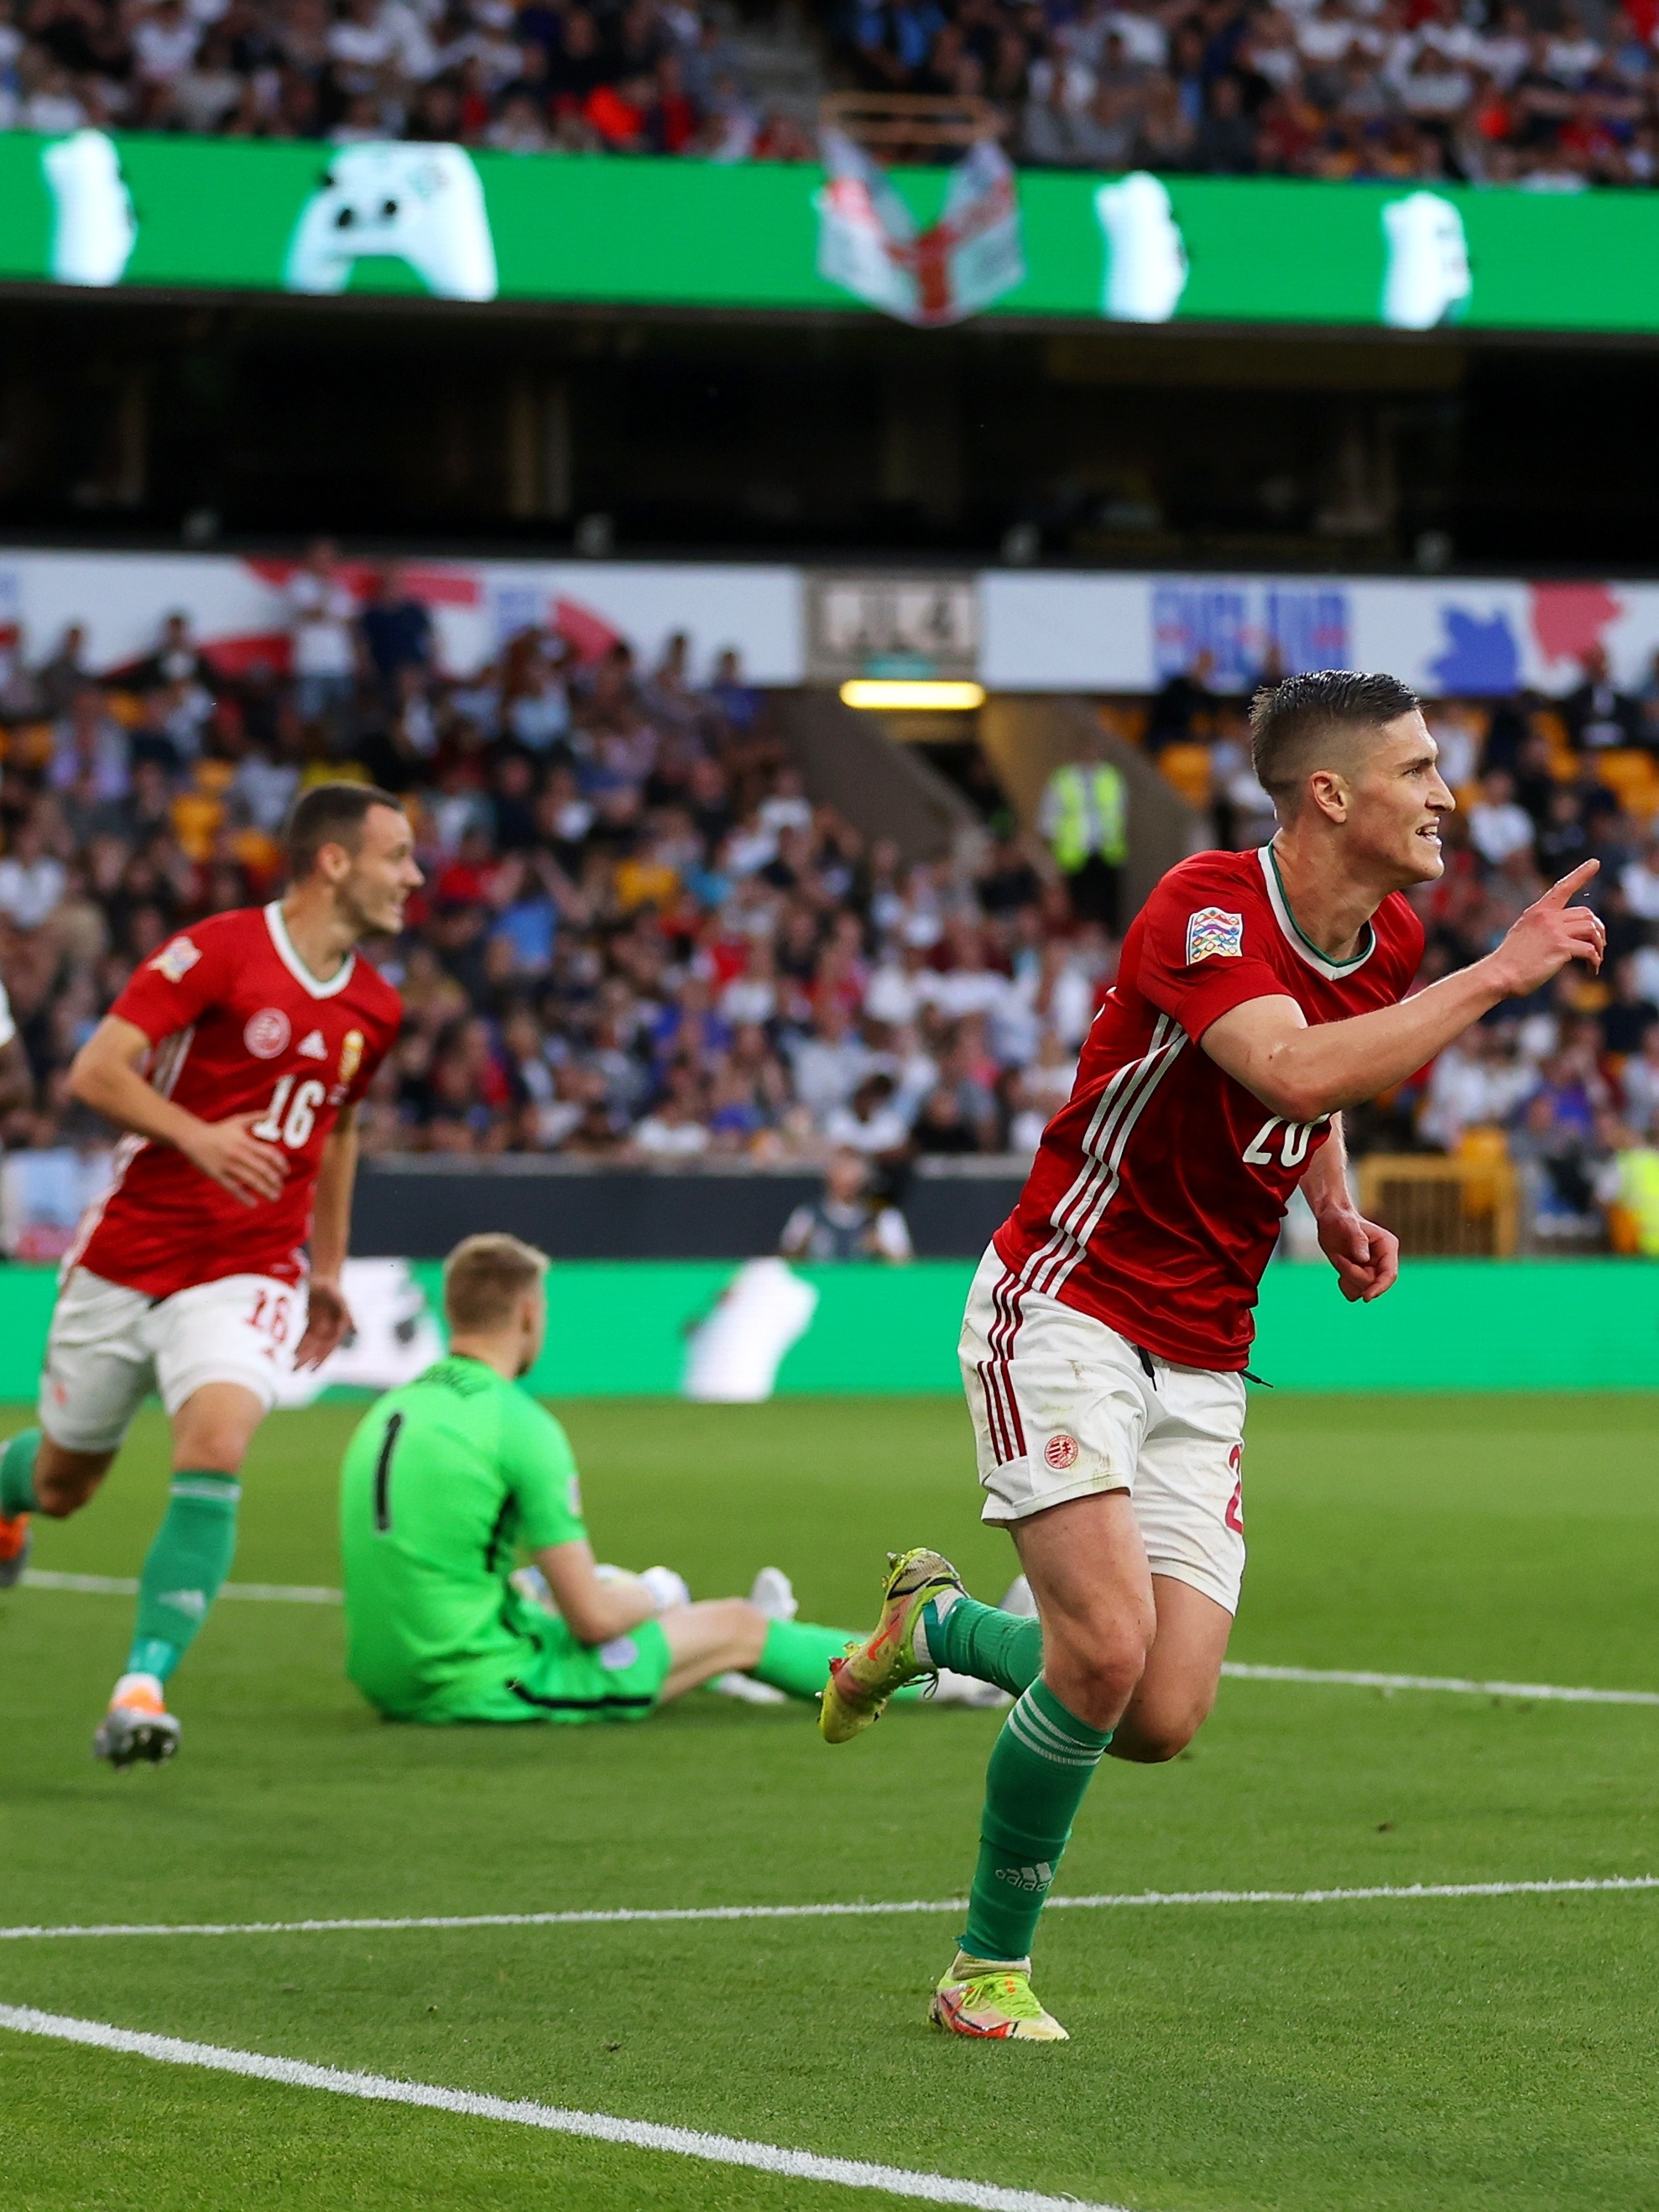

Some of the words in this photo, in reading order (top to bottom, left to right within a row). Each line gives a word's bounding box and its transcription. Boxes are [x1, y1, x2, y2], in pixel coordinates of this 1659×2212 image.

[252, 1074, 326, 1149] 16
[1242, 1113, 1330, 1166] 20
[373, 1411, 404, 1534] 1
[1225, 1444, 1244, 1536] 2
[994, 1868, 1049, 1892] adida
